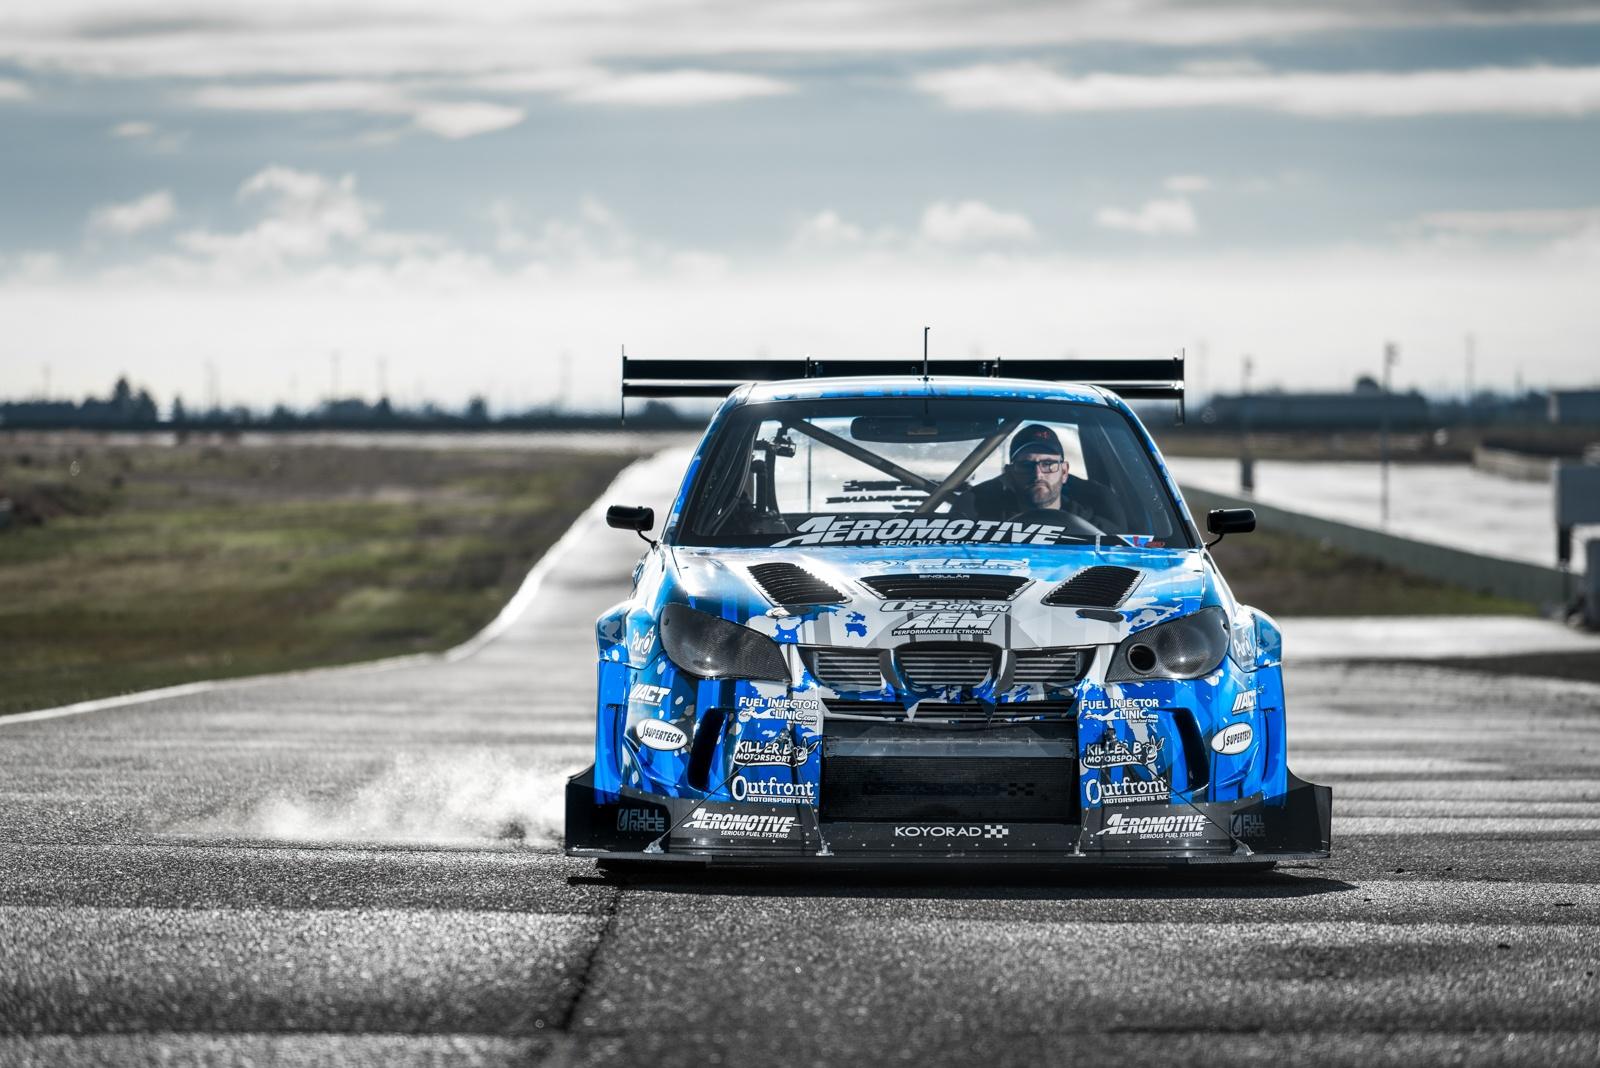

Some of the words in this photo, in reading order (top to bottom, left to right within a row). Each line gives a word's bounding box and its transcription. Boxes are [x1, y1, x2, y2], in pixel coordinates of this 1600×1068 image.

[769, 515, 1067, 546] AEROMOTIVE
[946, 603, 1012, 612] GIKEN
[898, 612, 1000, 629] AEM
[739, 697, 765, 707] FUEL
[767, 697, 819, 709] INJECTOR
[1081, 700, 1109, 710] FUEL
[1110, 699, 1159, 709] INJECTOR
[643, 726, 684, 744] SUPERTECH
[736, 741, 780, 756] KILLER
[1133, 742, 1142, 754] B
[735, 752, 791, 763] MOTORSPORT
[731, 775, 815, 801] Outfront
[1085, 776, 1168, 804] Outfront
[746, 796, 799, 804] MOTORSPORTS
[1103, 796, 1156, 804] MOTORSPORTS
[629, 809, 664, 820] FULL
[682, 807, 797, 833] AEROMOTIVE
[628, 820, 665, 832] RACE
[1096, 813, 1208, 835] AEROMOTIVE
[895, 826, 981, 837] KOYORAD
